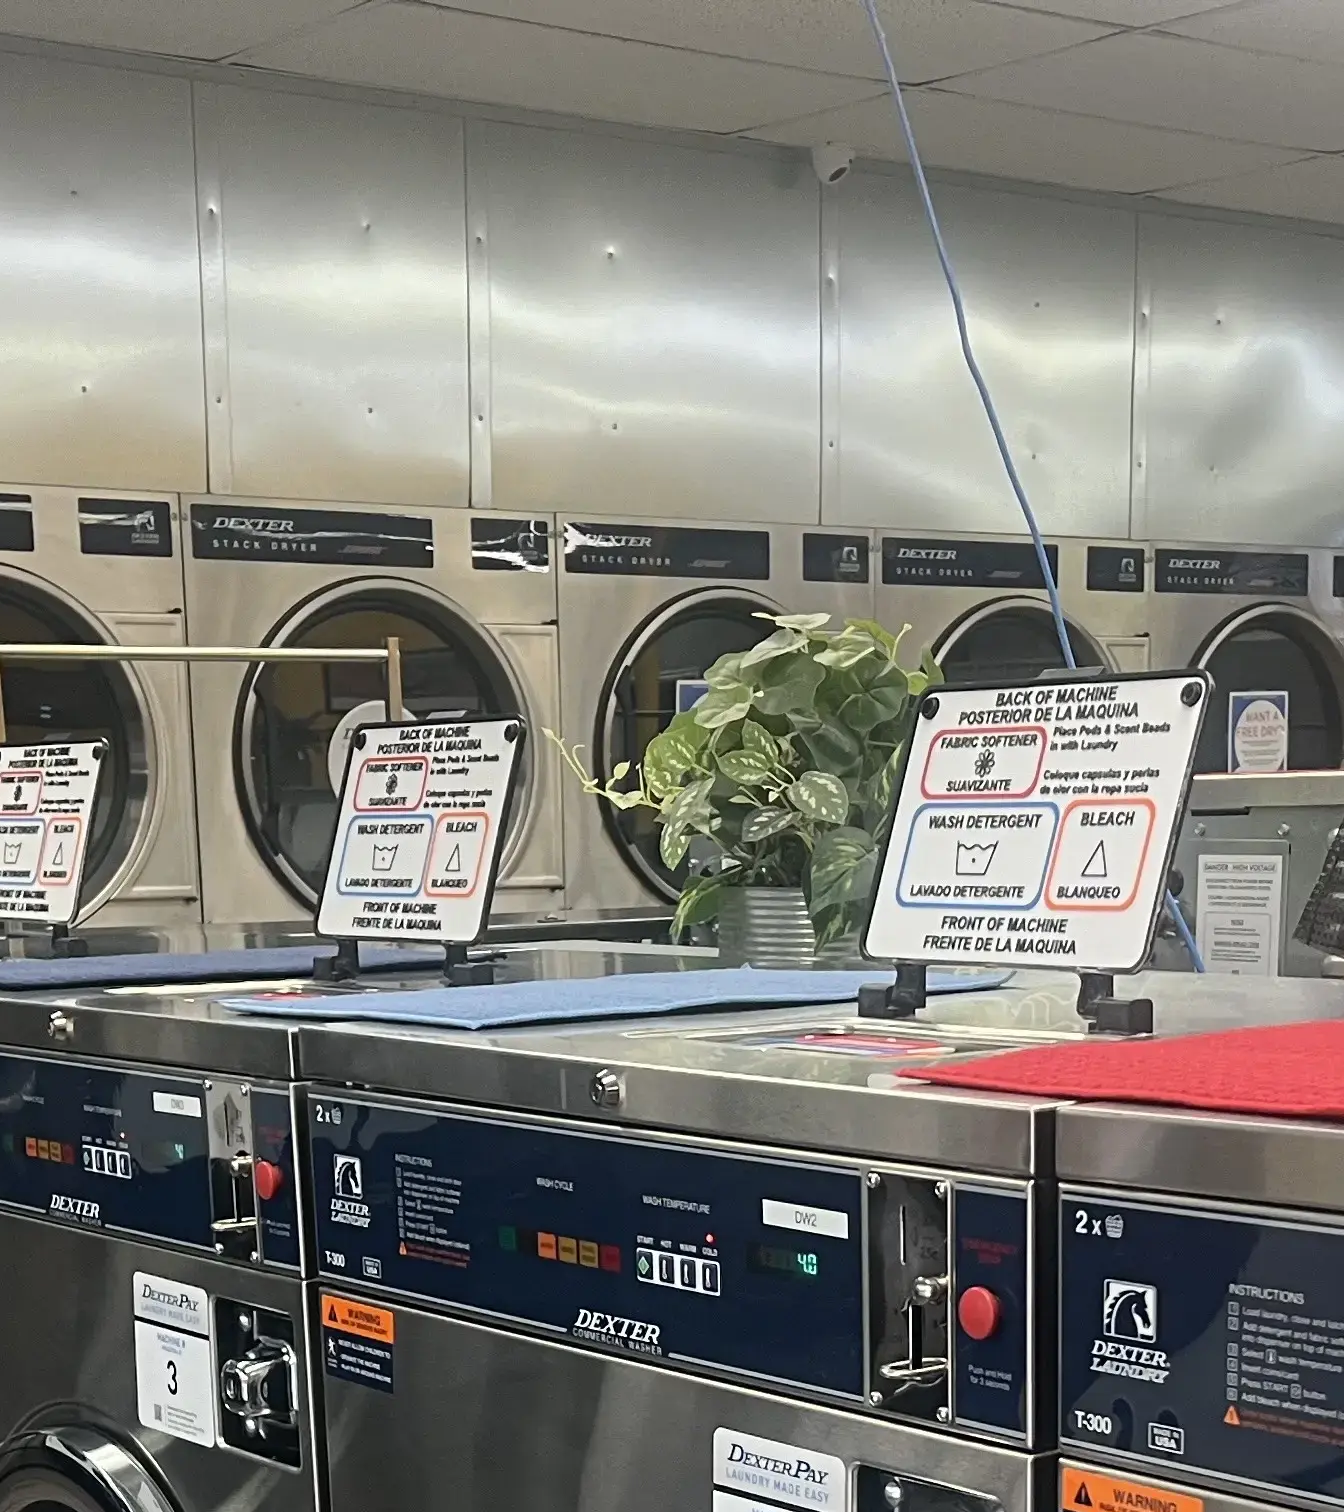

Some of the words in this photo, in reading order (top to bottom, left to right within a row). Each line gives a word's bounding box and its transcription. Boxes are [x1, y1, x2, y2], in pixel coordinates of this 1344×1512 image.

[213, 517, 294, 532] DEXTER
[897, 548, 957, 560] DEXTER
[1168, 559, 1220, 570] DEXTER
[996, 692, 1032, 708] BACK
[1035, 690, 1054, 704] OF
[1056, 686, 1118, 702] MACHINE
[958, 709, 1032, 725] POSTERIOR
[1035, 708, 1053, 722] DE
[1055, 707, 1073, 721] LA
[1075, 702, 1139, 719] MAQUINA
[399, 729, 420, 740] BACK
[423, 728, 433, 739] OF
[941, 735, 978, 749] FABRIC
[981, 734, 1038, 748] SOFTENER
[946, 779, 1012, 792] SUAVIZANTE
[446, 822, 477, 833] BLEACH
[929, 814, 964, 829] WASH
[966, 814, 1043, 829] DETERGENT
[1080, 811, 1135, 826] BLEACH
[910, 884, 951, 897] LAVADO
[953, 885, 1025, 899] DETERGENTE
[1057, 885, 1120, 899] BLANQUEO
[363, 902, 388, 913] FRONT
[390, 903, 401, 913] OF
[941, 915, 984, 931] FRONT
[987, 916, 1004, 931] OF
[1007, 917, 1068, 933] MACHINE
[923, 935, 972, 951] FRENTE
[975, 937, 993, 951] DE
[995, 937, 1013, 952] LA
[1015, 938, 1076, 954] MAQUINA
[50, 1194, 100, 1218] DEXTER
[331, 1199, 369, 1216] DEXTER
[794, 1210, 817, 1228] DW2
[1075, 1210, 1088, 1234] 2
[325, 1251, 345, 1267] T-300
[1228, 1283, 1305, 1305] INSTRUCTIONS
[574, 1308, 660, 1345] DEXTER
[1091, 1339, 1168, 1368] DEXTER
[167, 1360, 178, 1395] 3
[1090, 1357, 1170, 1384] LAUNDRY
[1074, 1411, 1112, 1434] T-300
[727, 1443, 829, 1485] DEXTERPAY
[726, 1467, 769, 1489] LAUNDRY
[773, 1479, 801, 1496] MADE
[805, 1488, 829, 1504] EASY
